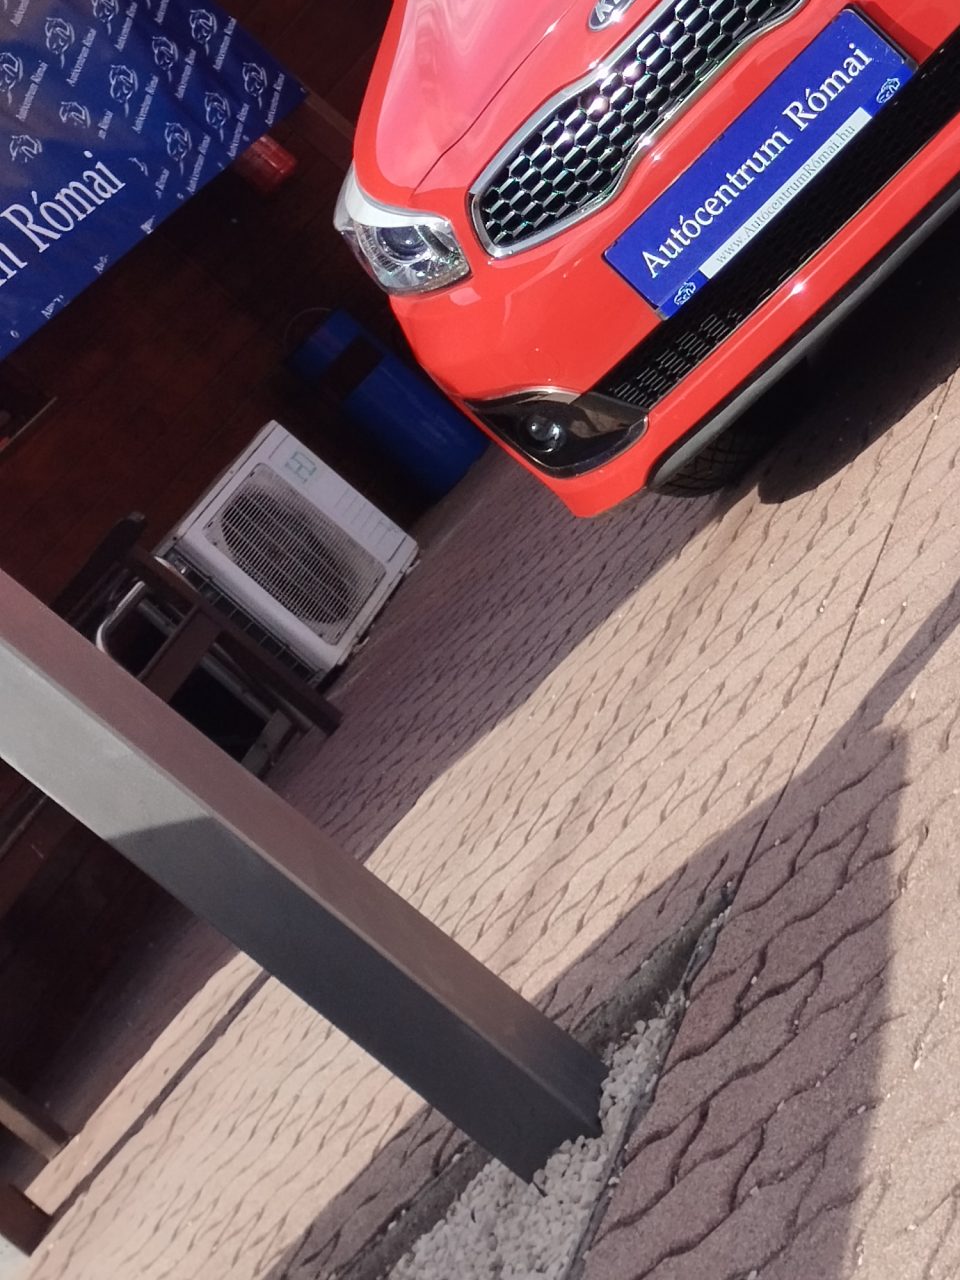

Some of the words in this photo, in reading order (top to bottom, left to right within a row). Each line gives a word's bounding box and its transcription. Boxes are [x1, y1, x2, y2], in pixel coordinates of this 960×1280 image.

[0, 150, 126, 253] Római
[641, 130, 793, 278] Autócentrum
[782, 42, 872, 131] Római
[715, 123, 856, 265] www.AutócentrumRómai.hu
